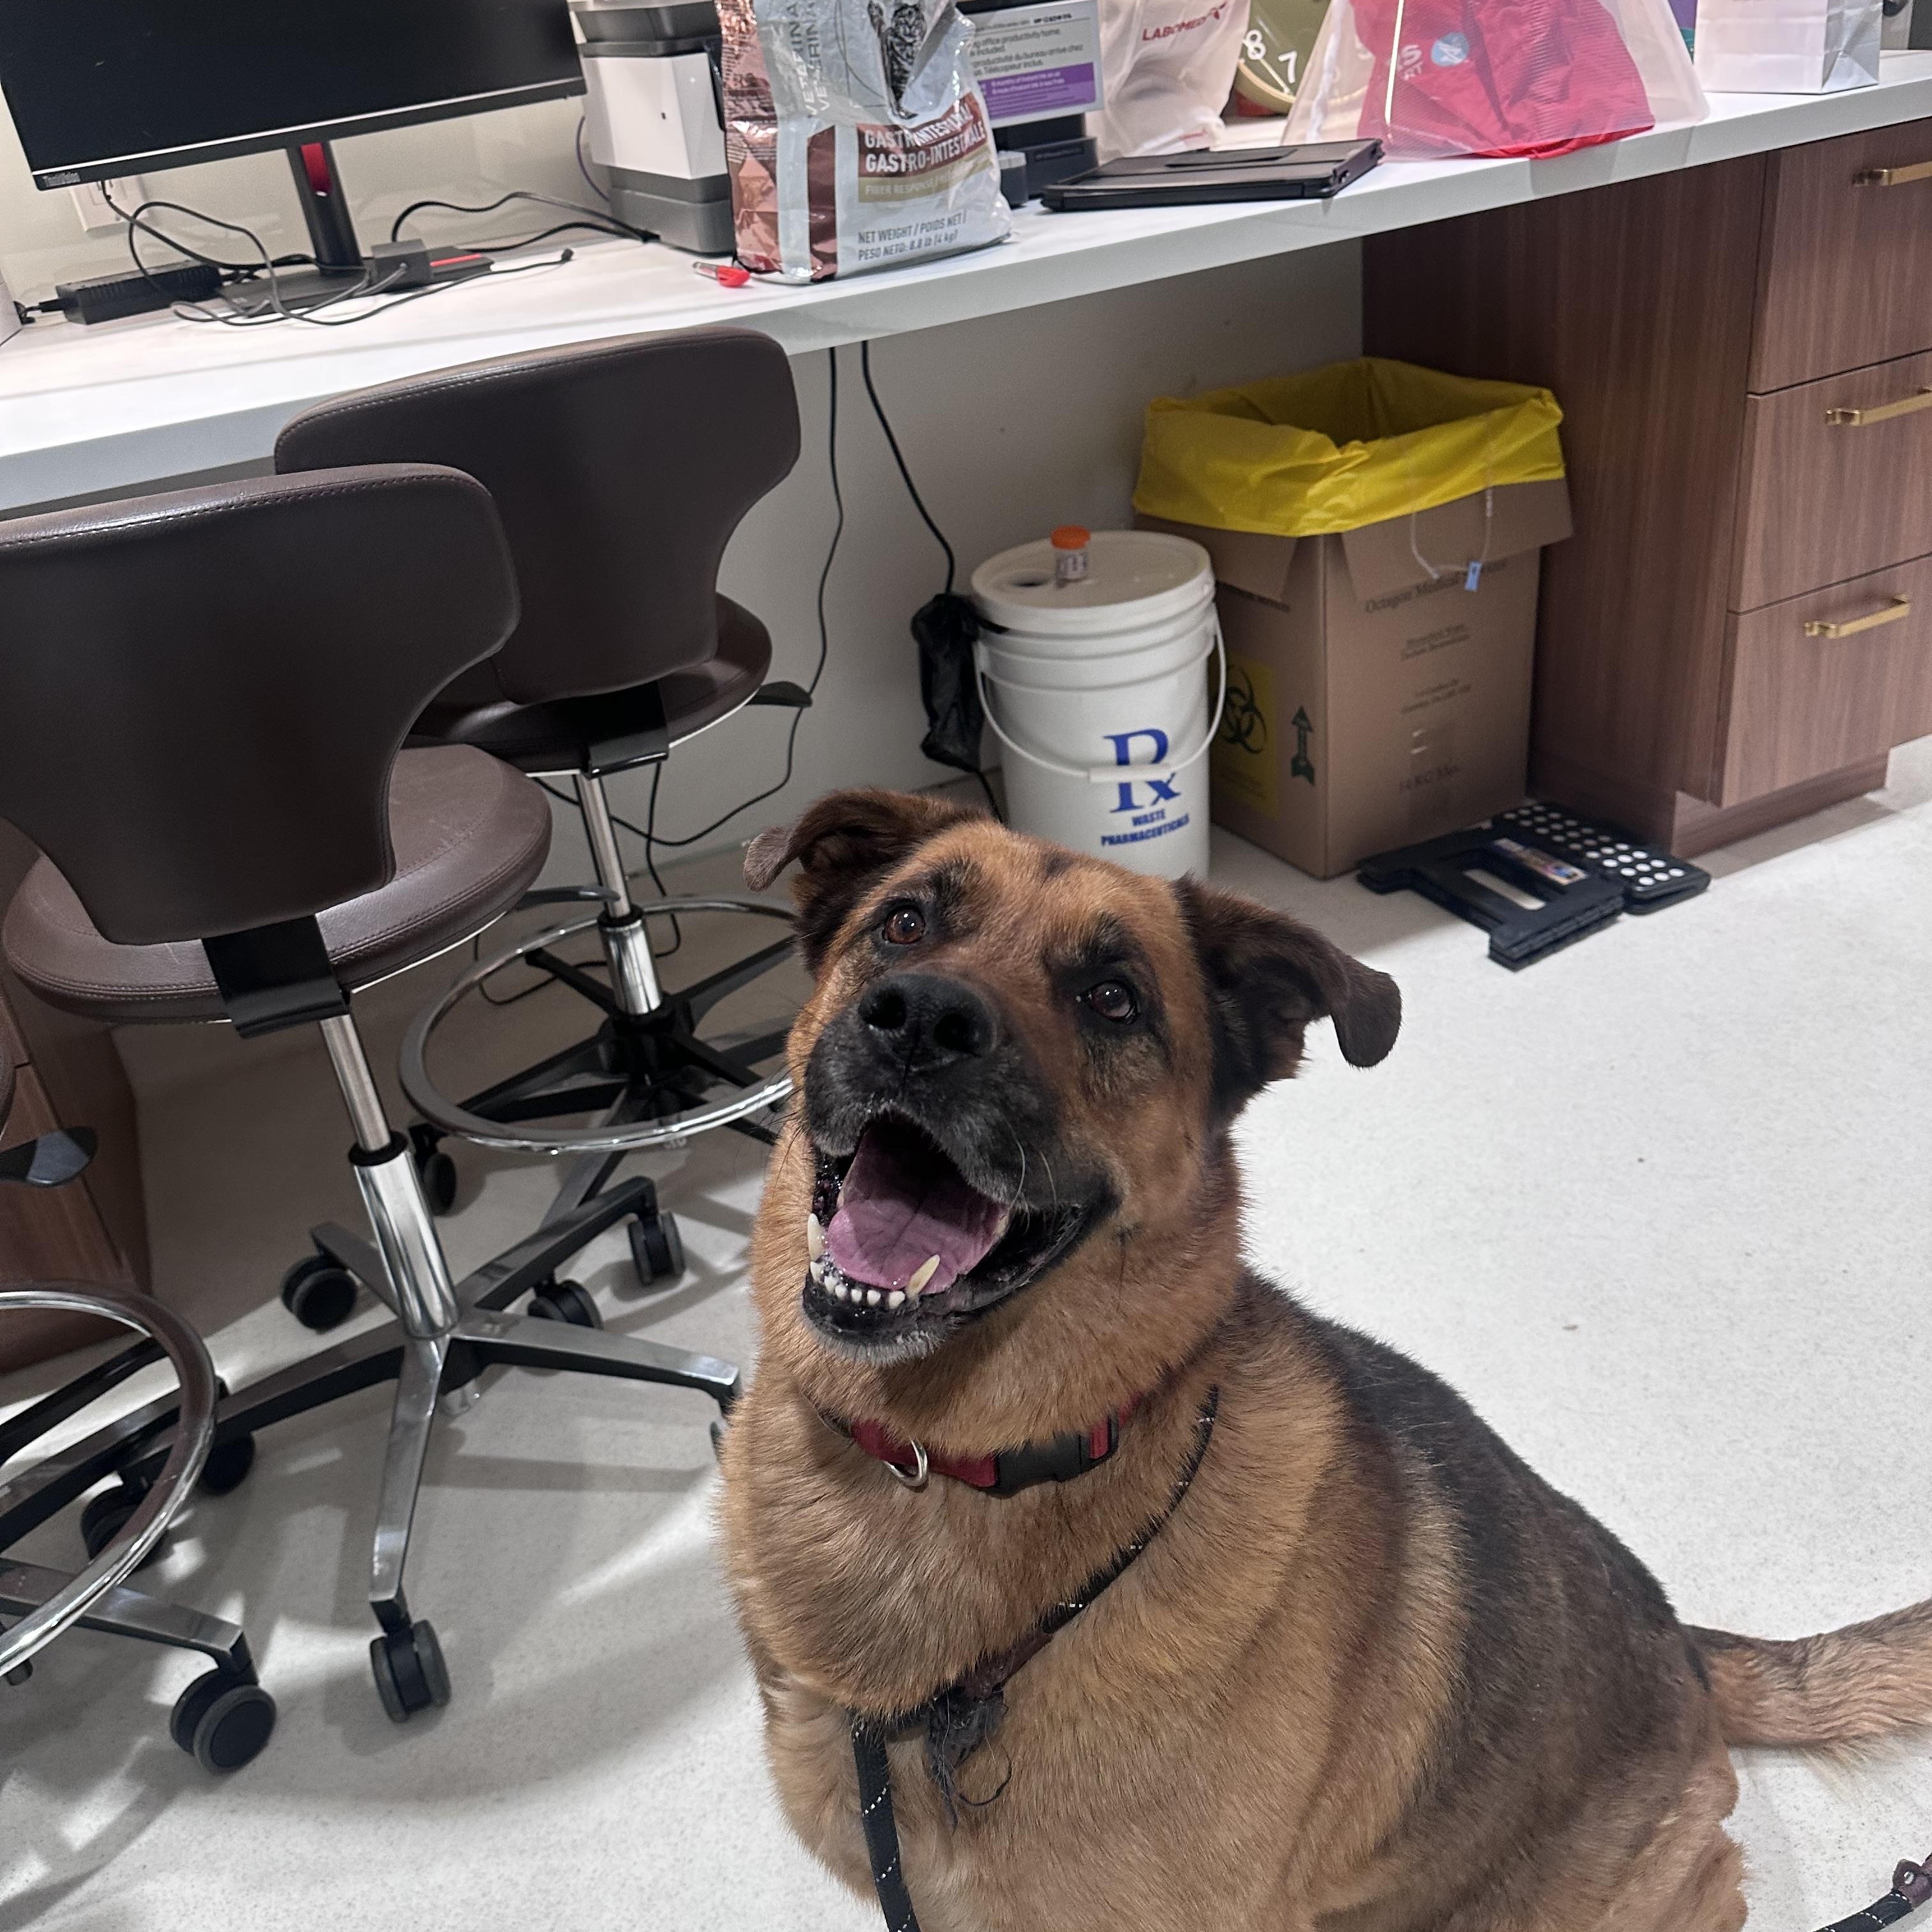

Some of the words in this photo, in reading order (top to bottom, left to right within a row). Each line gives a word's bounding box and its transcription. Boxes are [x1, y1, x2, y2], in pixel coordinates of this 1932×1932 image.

[1246, 29, 1266, 60] 8
[1278, 51, 1297, 83] 7
[858, 231, 876, 244] NET
[878, 225, 914, 242] WEIGHT
[920, 218, 945, 234] POIDS
[946, 213, 962, 227] NET
[858, 247, 881, 261] PESO
[1131, 808, 1166, 827] WASTE
